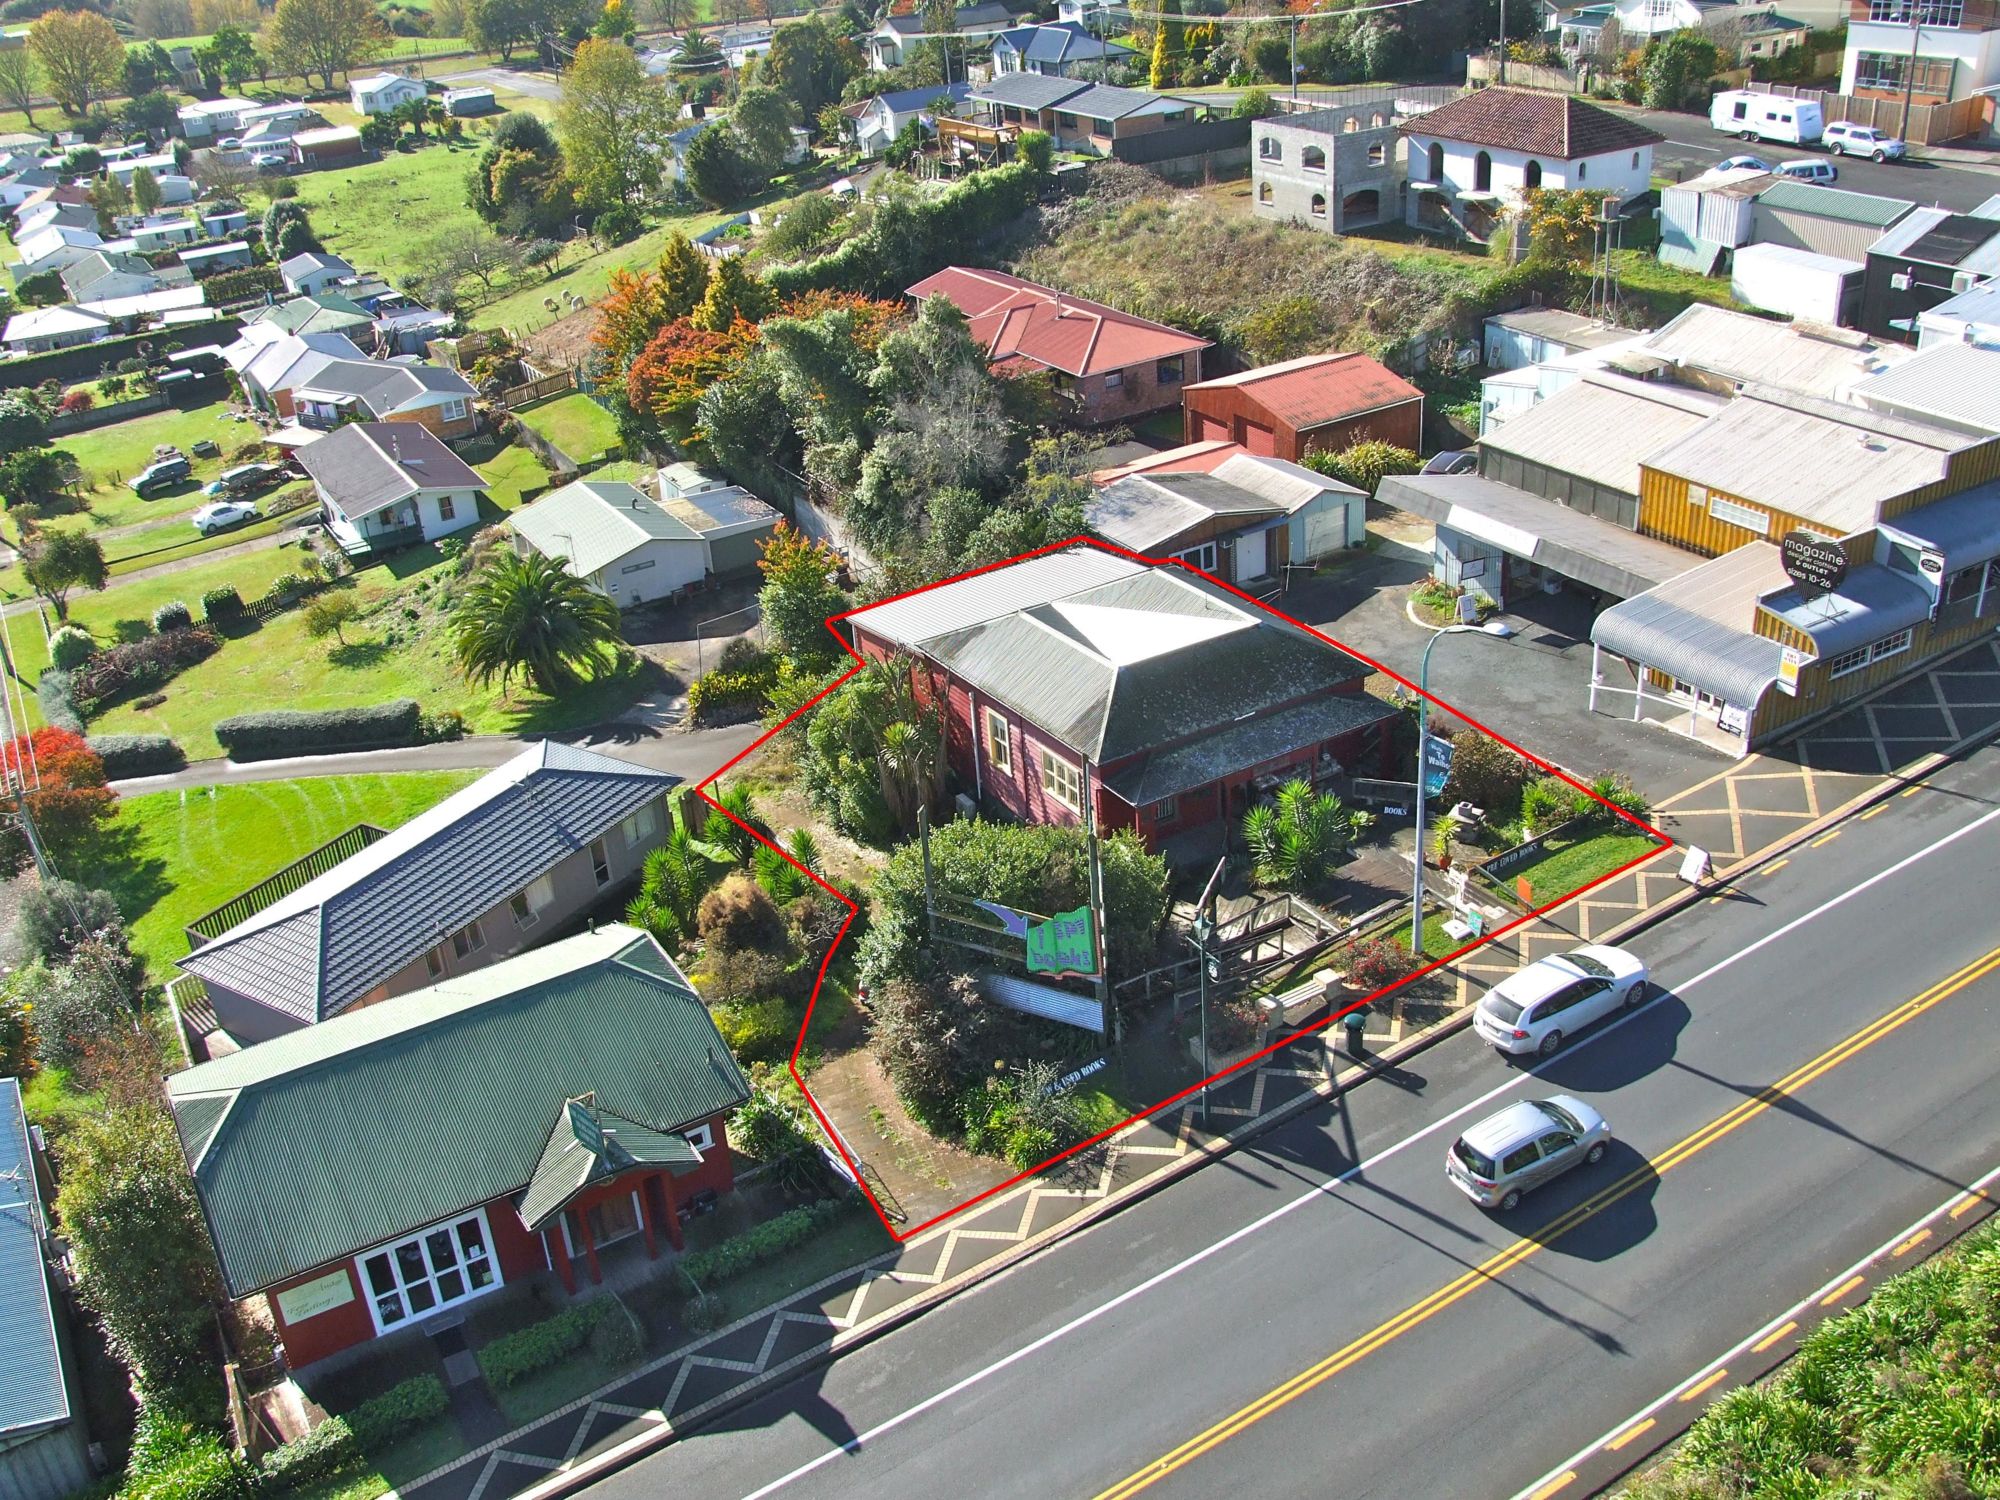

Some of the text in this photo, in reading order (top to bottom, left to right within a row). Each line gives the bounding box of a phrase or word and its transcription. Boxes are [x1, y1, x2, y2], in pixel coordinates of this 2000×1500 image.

[1785, 540, 1844, 565] magazine
[1787, 551, 1838, 573] designer clothing
[1787, 568, 1831, 588] sizes 10-26
[1802, 563, 1829, 575] OUTLET
[1384, 806, 1408, 816] BOOKS
[1081, 1058, 1106, 1077] BOOKS
